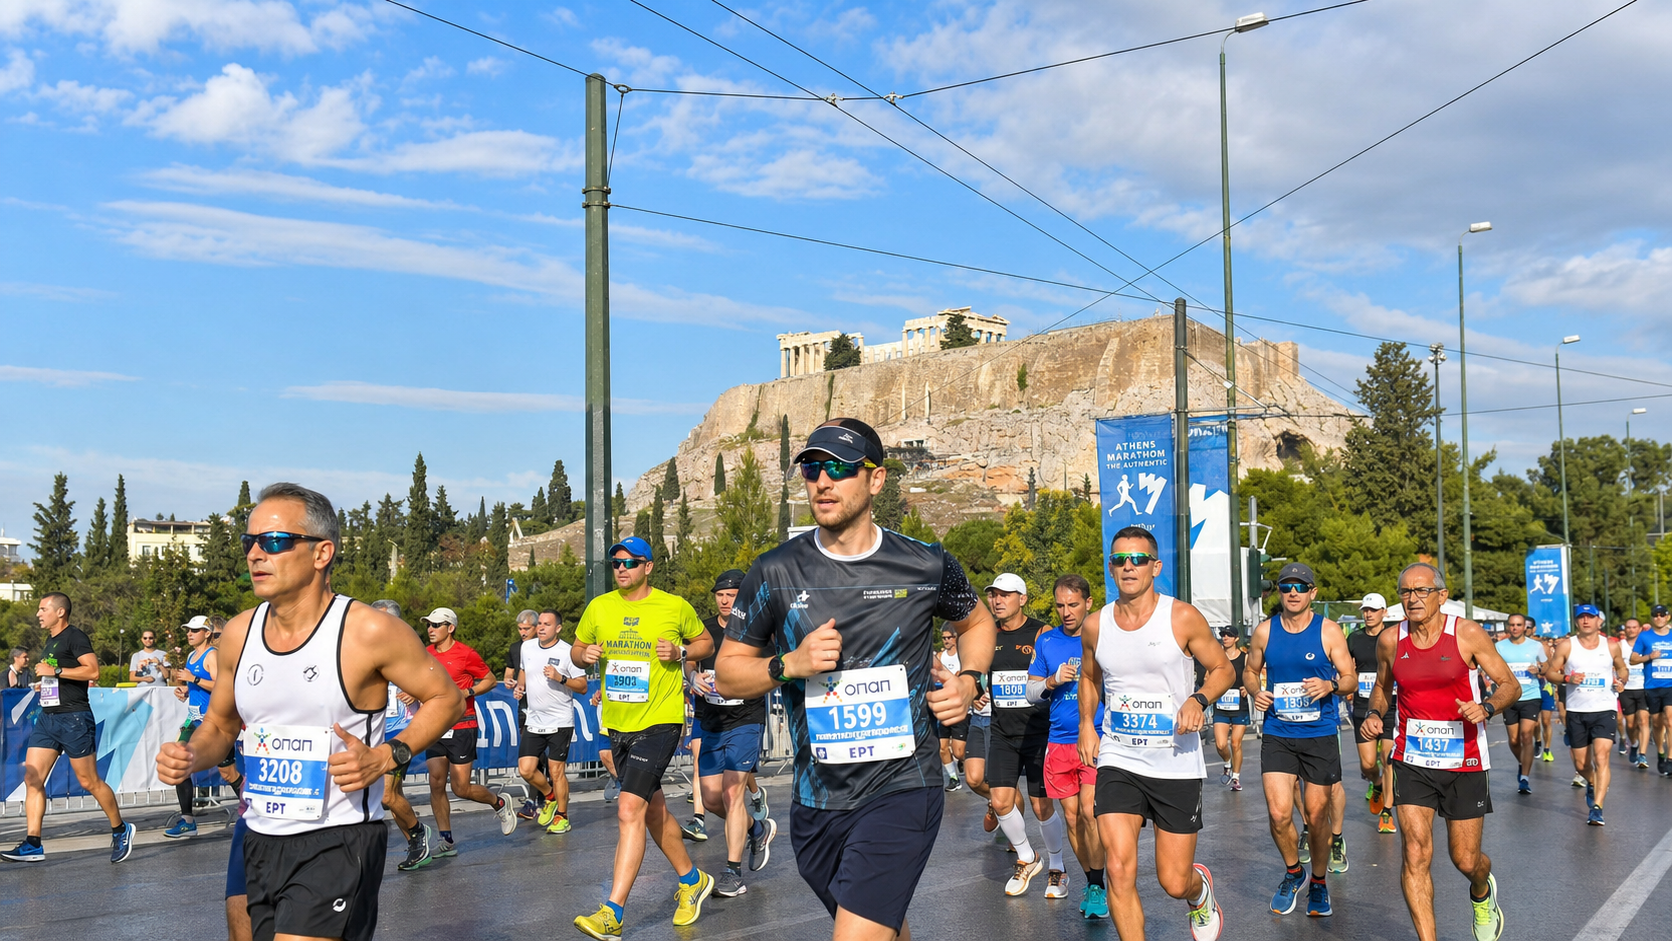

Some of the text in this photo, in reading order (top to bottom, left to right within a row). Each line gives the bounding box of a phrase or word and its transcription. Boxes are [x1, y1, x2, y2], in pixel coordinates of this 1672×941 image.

[1115, 440, 1156, 451] ATHENS
[606, 640, 652, 650] MARATHON
[828, 702, 887, 730] 1599
[1122, 713, 1158, 729] 3374
[1417, 737, 1450, 752] 1437
[258, 758, 303, 785] 3208
